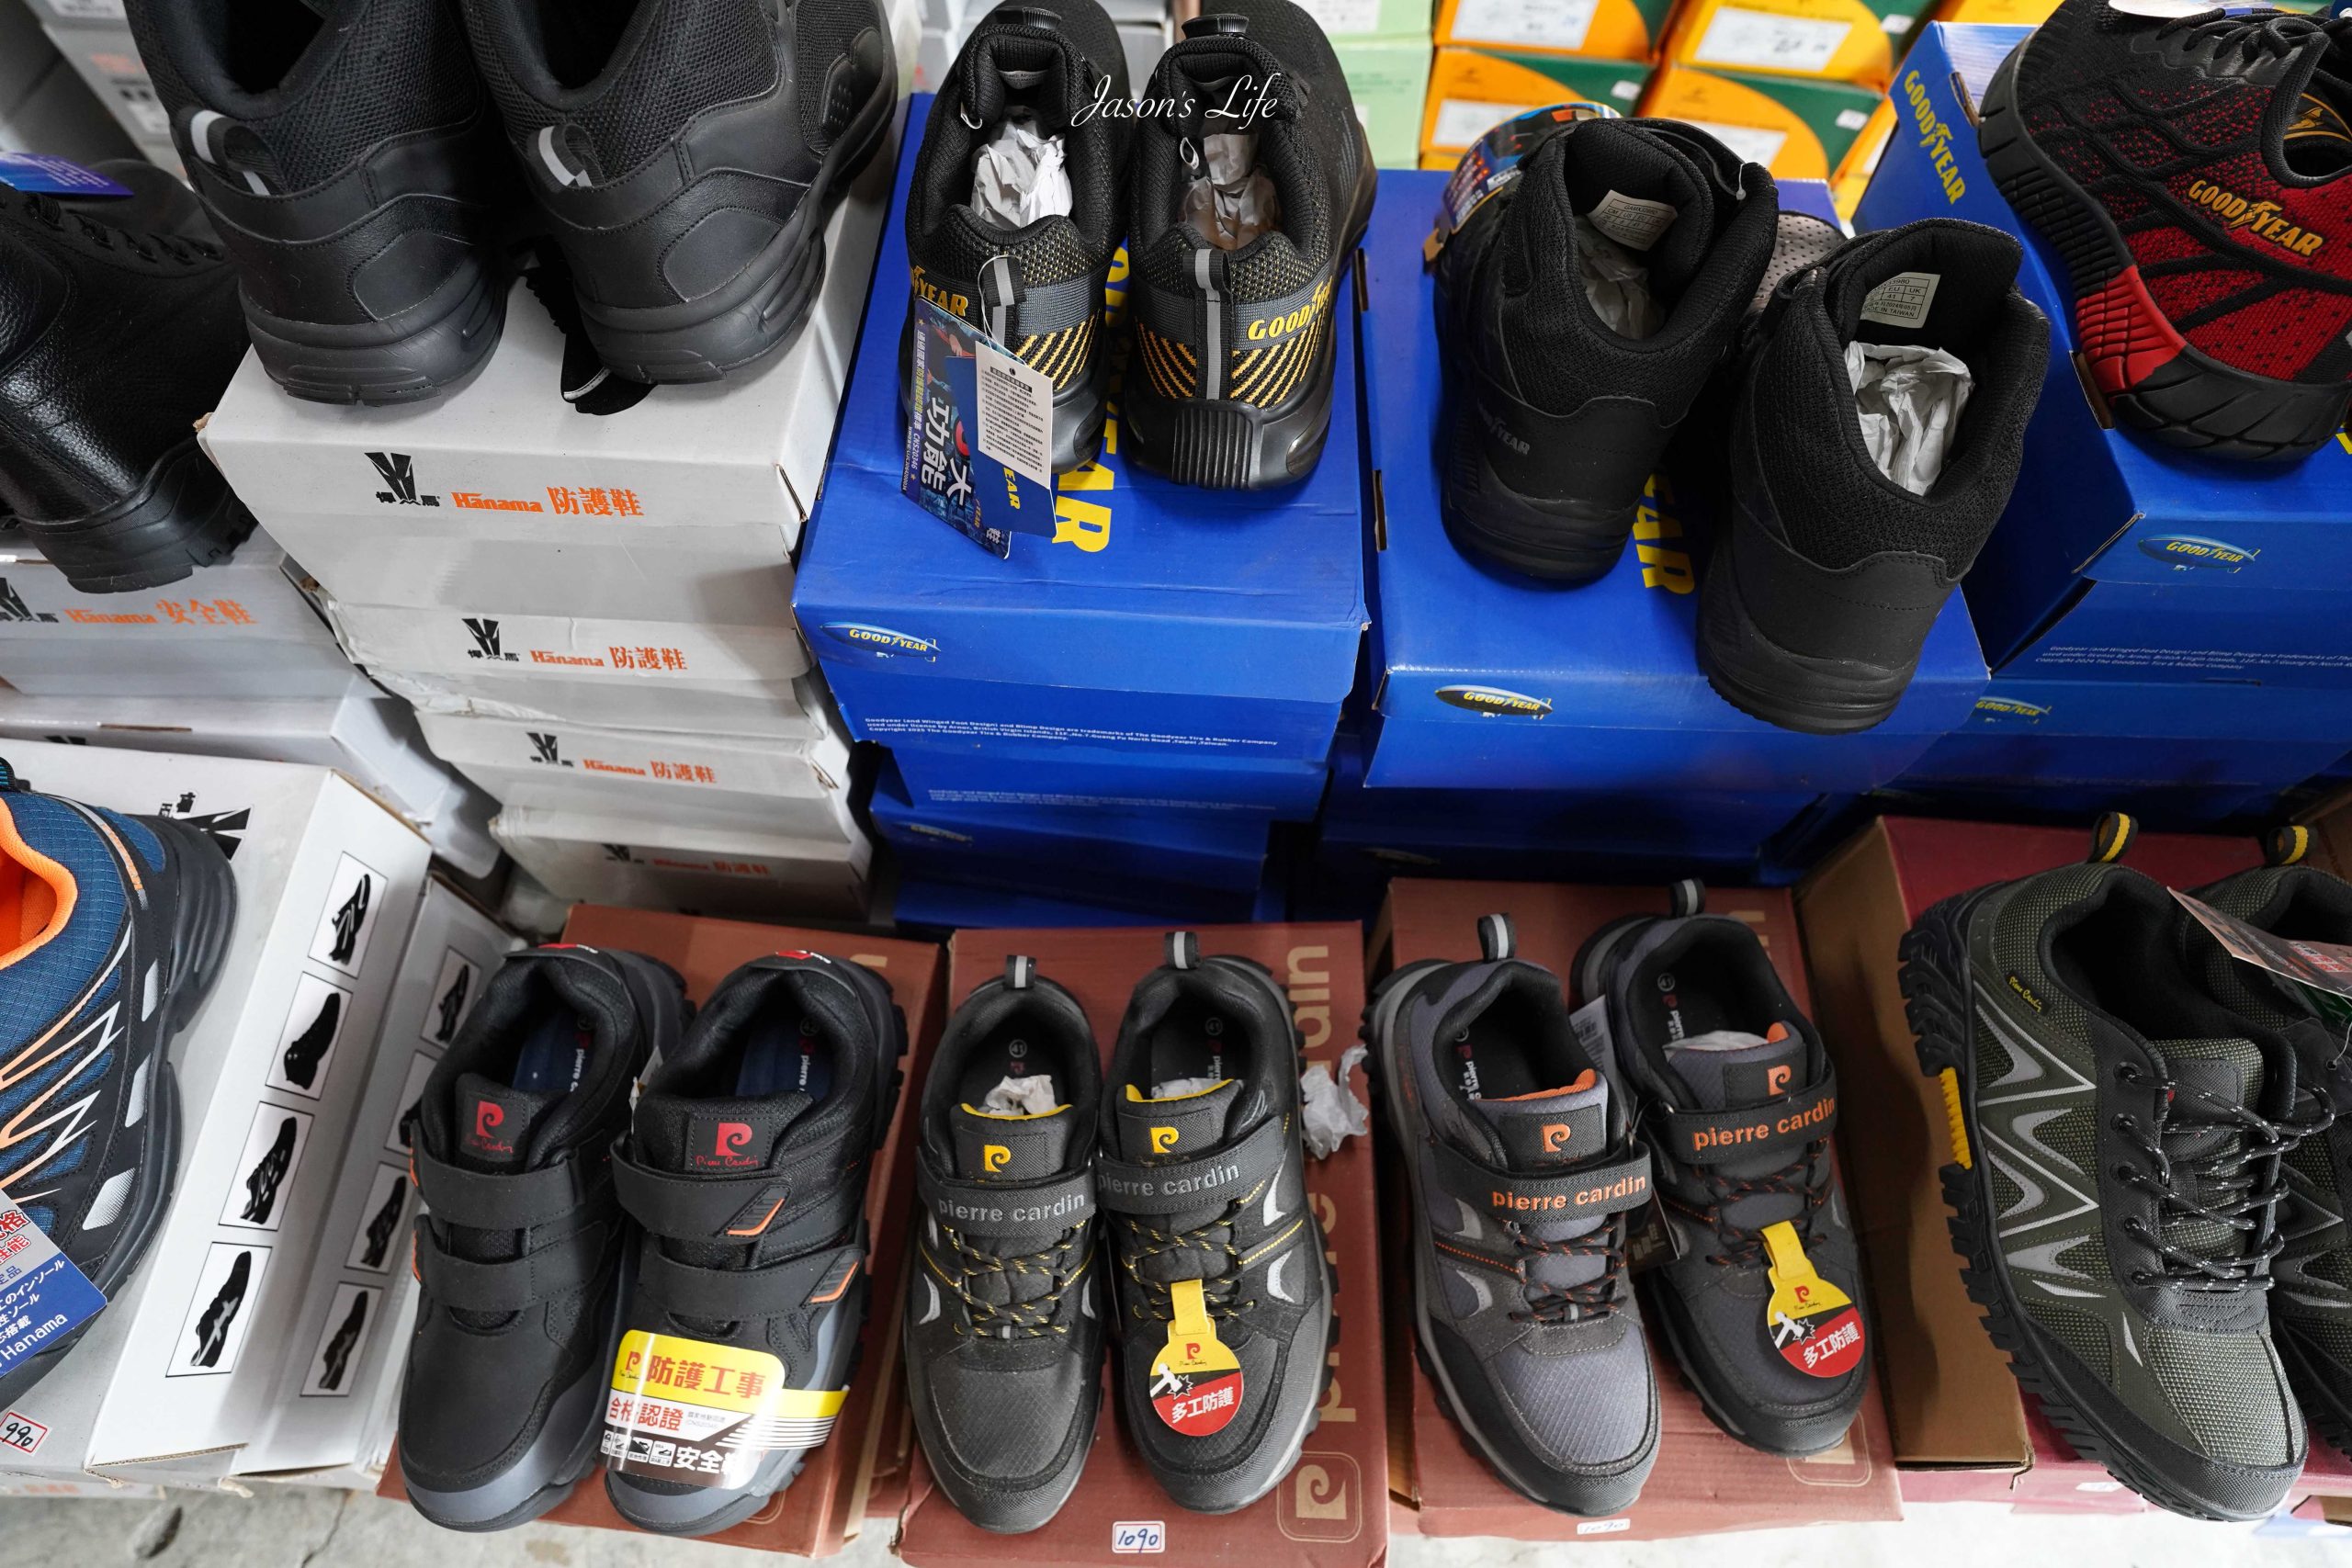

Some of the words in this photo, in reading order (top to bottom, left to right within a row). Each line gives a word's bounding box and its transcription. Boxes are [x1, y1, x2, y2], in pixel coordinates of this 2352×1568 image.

[1904, 69, 1966, 205] GOODYEAR
[2188, 180, 2324, 257] GOODYEAR
[921, 397, 950, 491] 功能
[547, 486, 644, 516] 防護鞋
[2166, 541, 2245, 563] GOODYEAR
[155, 599, 259, 626] 安全鞋
[849, 628, 928, 652] GOODYEAR
[608, 646, 688, 671] 防護鞋
[1464, 691, 1541, 711] GOODYEAR
[650, 760, 718, 784] 防護鞋
[1692, 1123, 1770, 1152] pierre
[1777, 1098, 1836, 1134] cardin
[1098, 1173, 1156, 1197] pierre
[1162, 1164, 1241, 1196] cardin
[1492, 1190, 1567, 1211] pierre
[1575, 1175, 1646, 1206] cardin
[939, 1199, 1004, 1223] pierre
[1012, 1193, 1085, 1222] cardin
[1, 1314, 69, 1361] Hanama
[1803, 1321, 1860, 1369] 多工防護
[646, 1355, 766, 1399] 防護工事
[608, 1396, 684, 1431] 合格認證
[1171, 1386, 1235, 1424] 多工防護
[2, 1422, 34, 1448] 990
[1117, 1528, 1159, 1553] 1090
